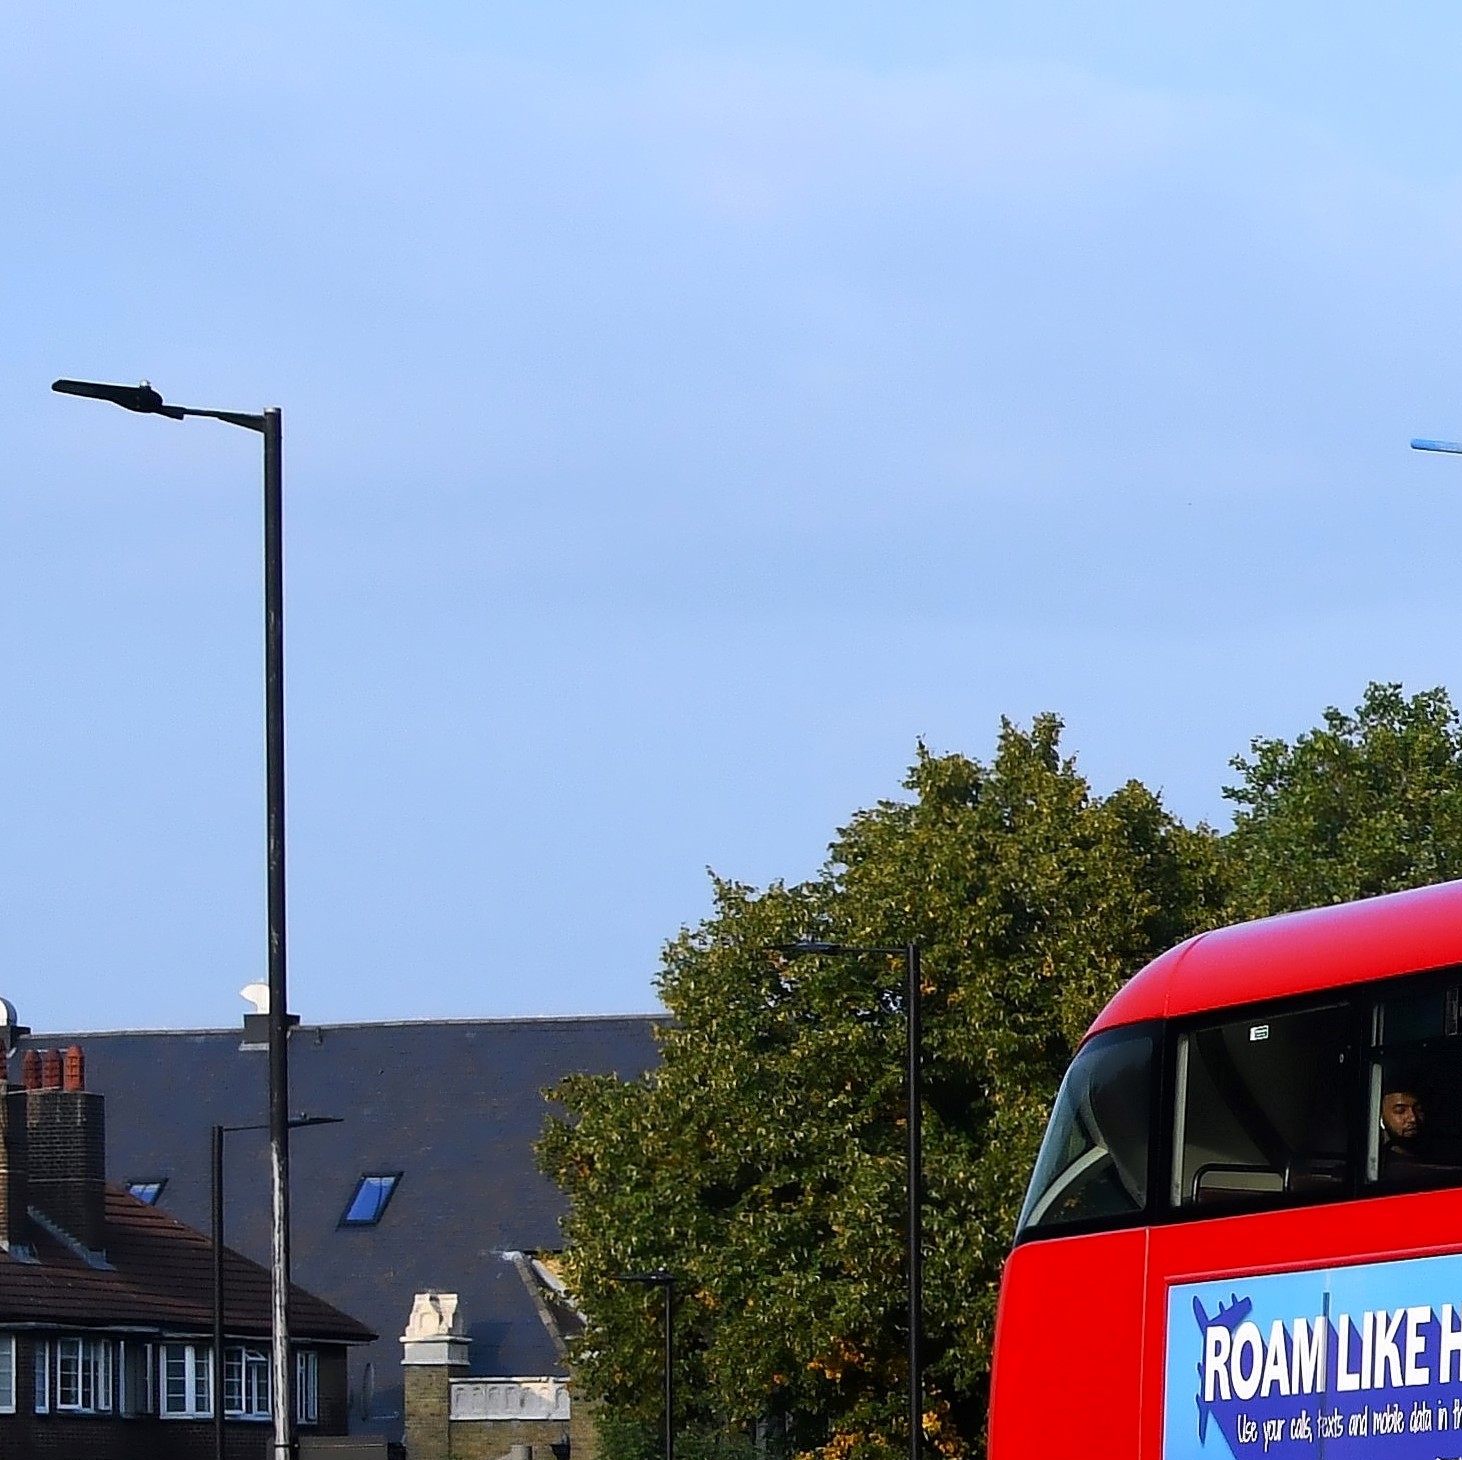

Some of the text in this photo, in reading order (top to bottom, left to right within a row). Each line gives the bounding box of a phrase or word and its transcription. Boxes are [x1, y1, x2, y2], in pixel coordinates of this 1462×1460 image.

[1204, 1315, 1326, 1402] ROAM
[1337, 1306, 1431, 1392] LIKE
[1237, 1413, 1258, 1443] Use
[1262, 1418, 1285, 1453] your
[1317, 1408, 1343, 1439] texts
[1349, 1405, 1368, 1437] and
[1373, 1404, 1405, 1436] mobile
[1410, 1401, 1432, 1434] data
[1438, 1400, 1448, 1431] in
